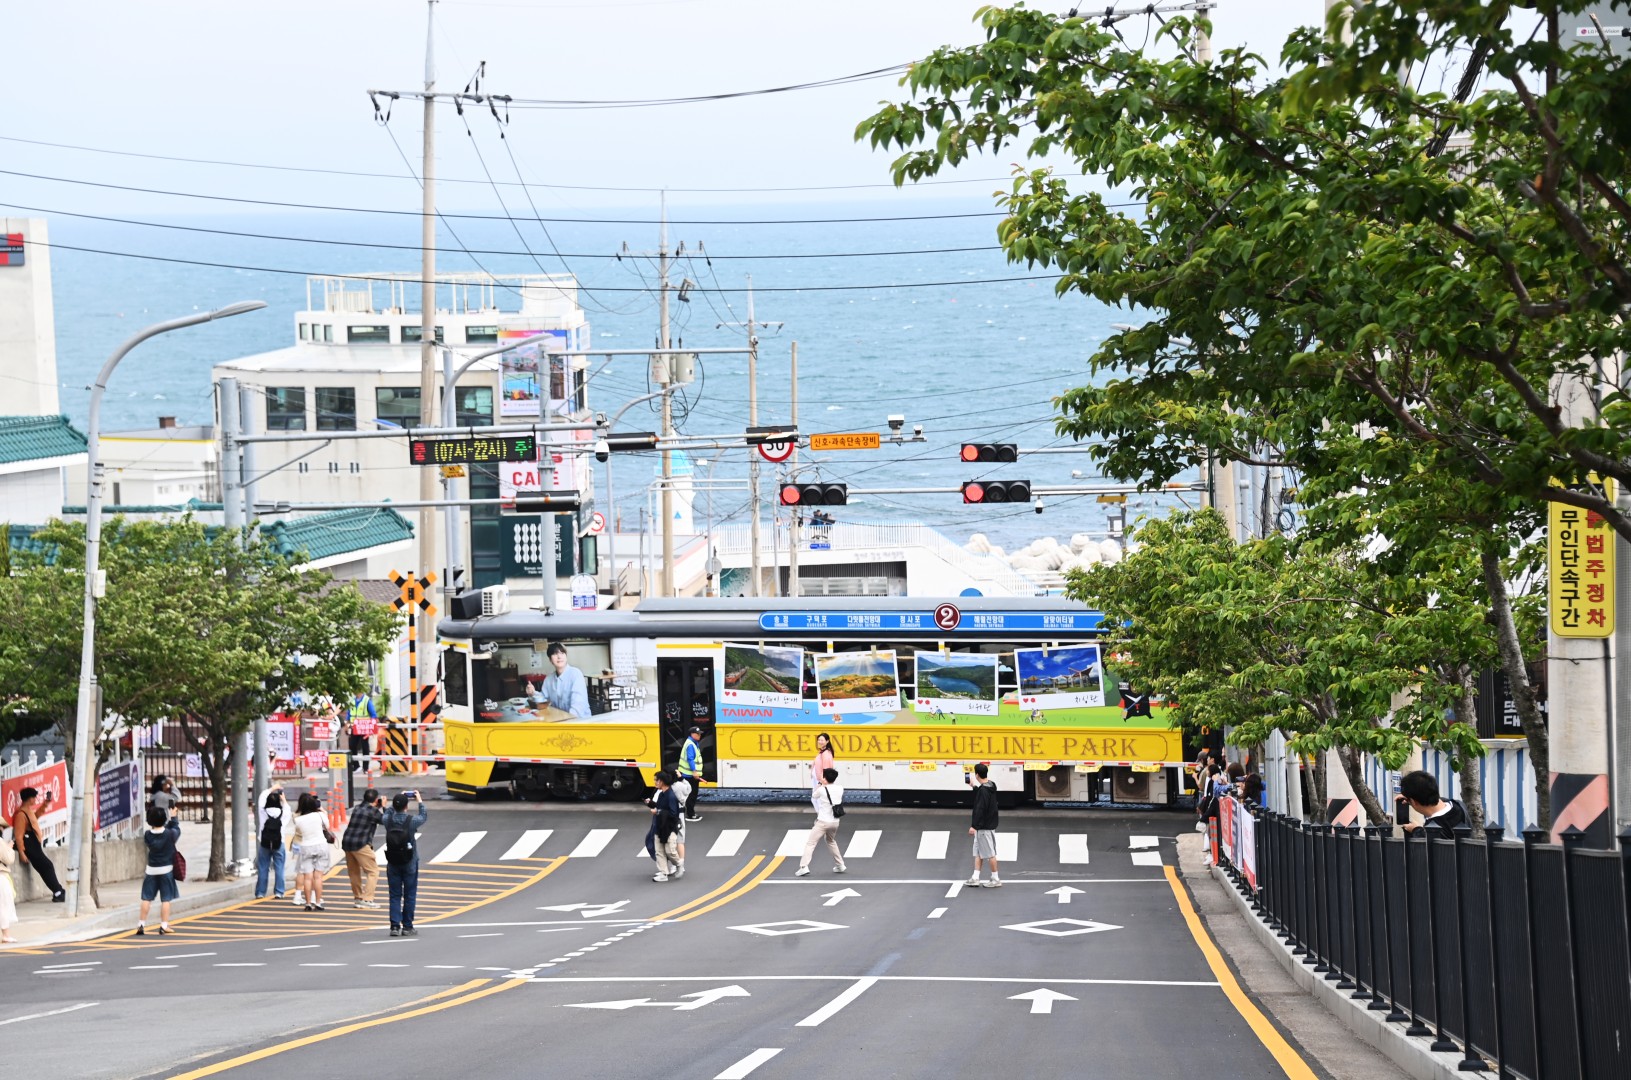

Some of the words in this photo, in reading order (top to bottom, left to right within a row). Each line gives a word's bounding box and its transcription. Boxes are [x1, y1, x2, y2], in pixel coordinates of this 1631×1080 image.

[512, 471, 559, 486] CAE
[1560, 510, 1581, 628] 무인단속구간
[940, 607, 955, 626] 2
[608, 687, 621, 699] 또
[623, 686, 647, 699] 만나
[611, 699, 643, 711] 대만!
[721, 708, 773, 718] TAIWAN
[270, 729, 288, 741] 주의
[758, 734, 901, 753] HAENDAE
[918, 735, 1046, 755] BLUELINE
[1062, 737, 1140, 757] PARK
